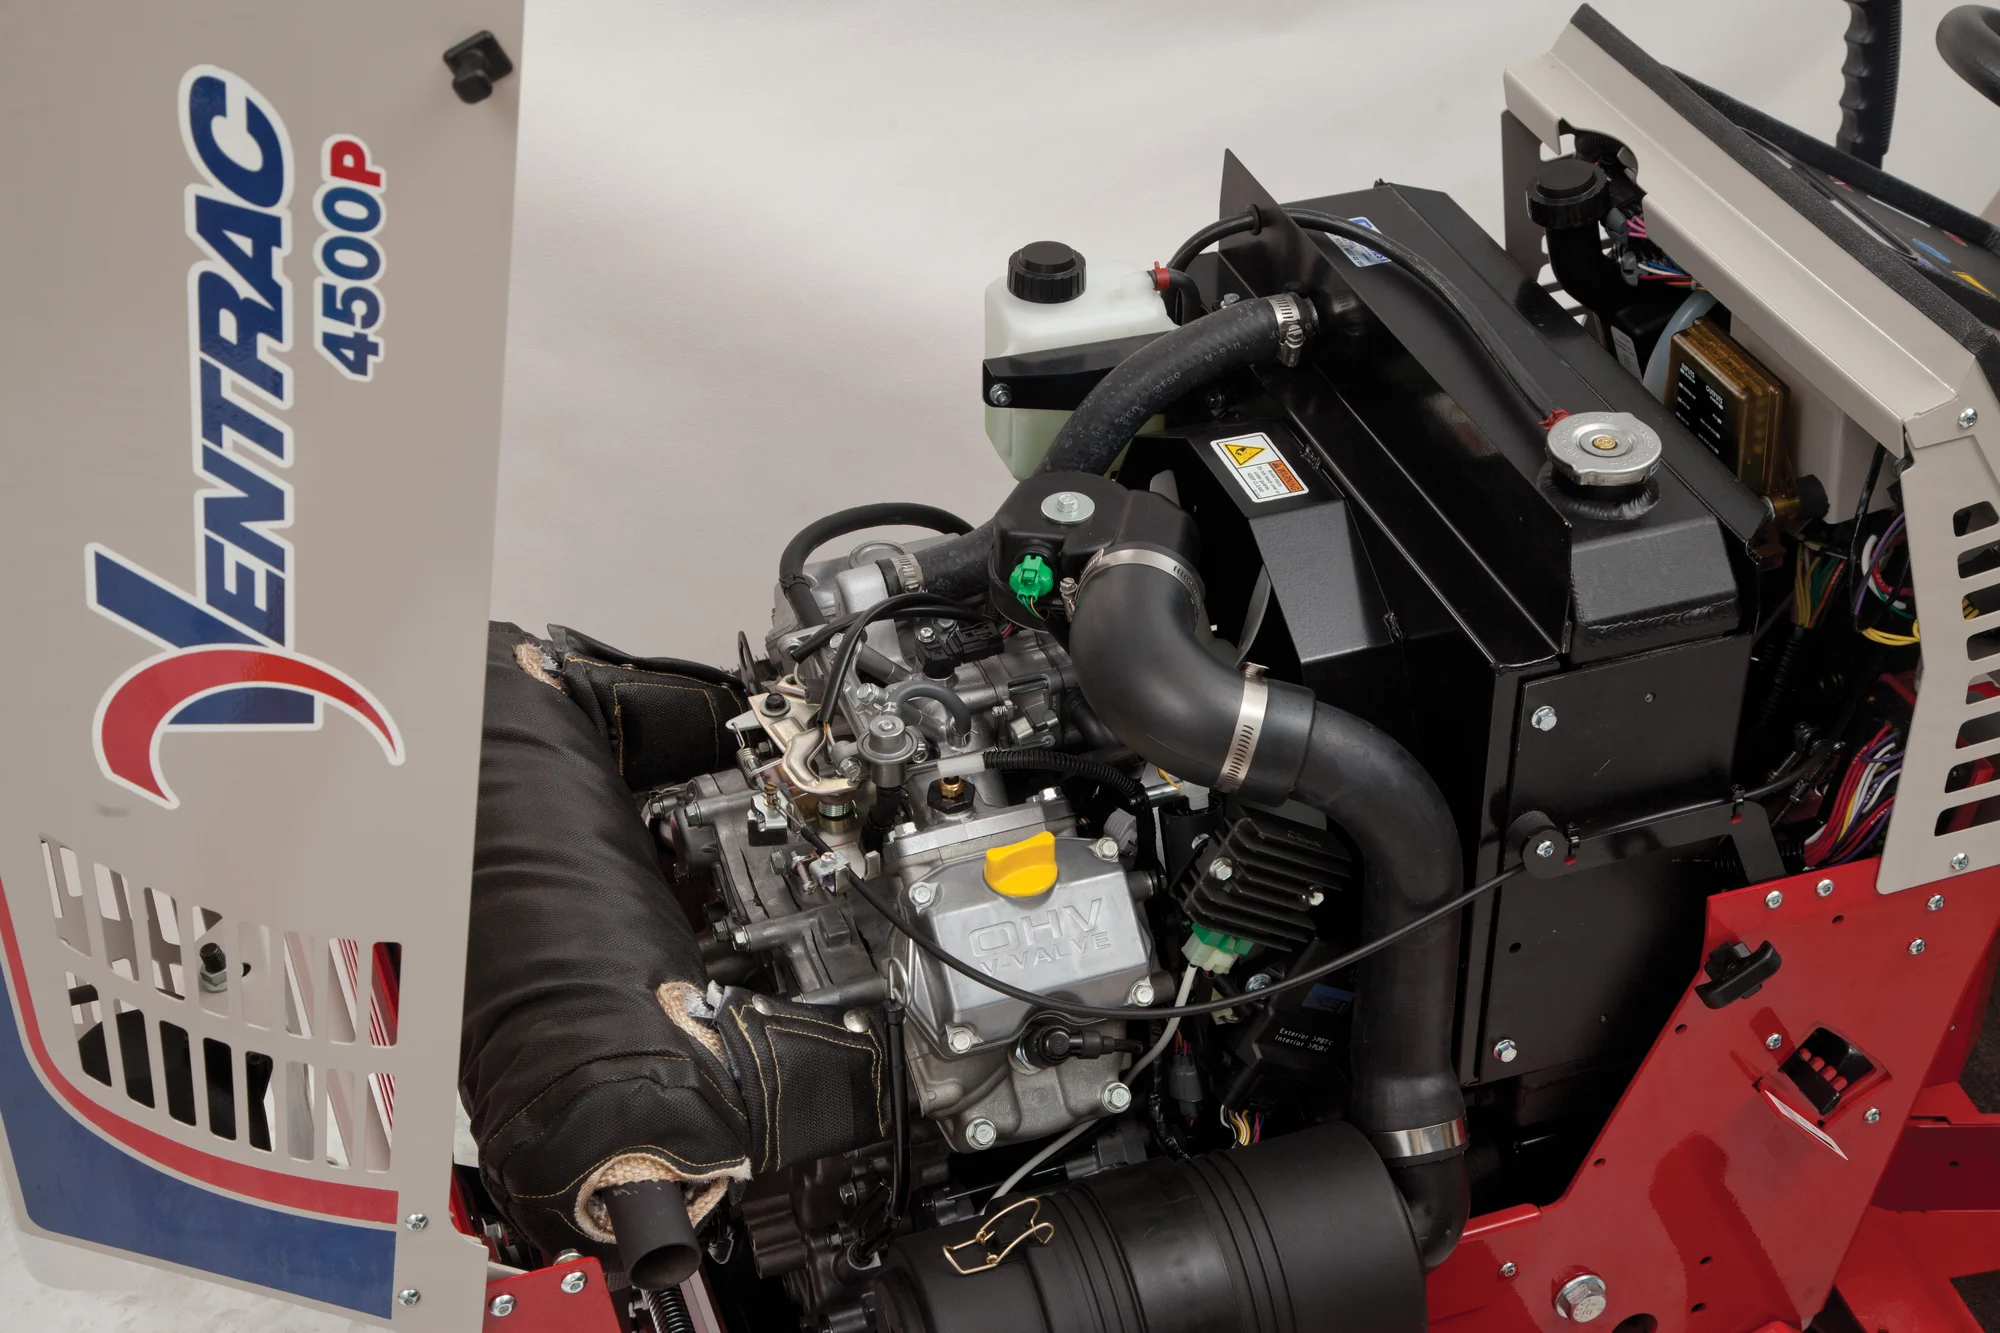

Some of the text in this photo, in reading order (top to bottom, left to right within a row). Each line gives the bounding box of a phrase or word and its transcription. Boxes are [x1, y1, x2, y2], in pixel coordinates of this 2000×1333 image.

[319, 137, 384, 380] 4500P
[86, 66, 322, 731] VENTRAC
[1278, 468, 1300, 490] WARNING
[968, 898, 1102, 957] OHV
[980, 931, 1112, 976] V-VALVE
[1274, 1034, 1305, 1047] Interior
[1279, 1027, 1309, 1040] Exterior
